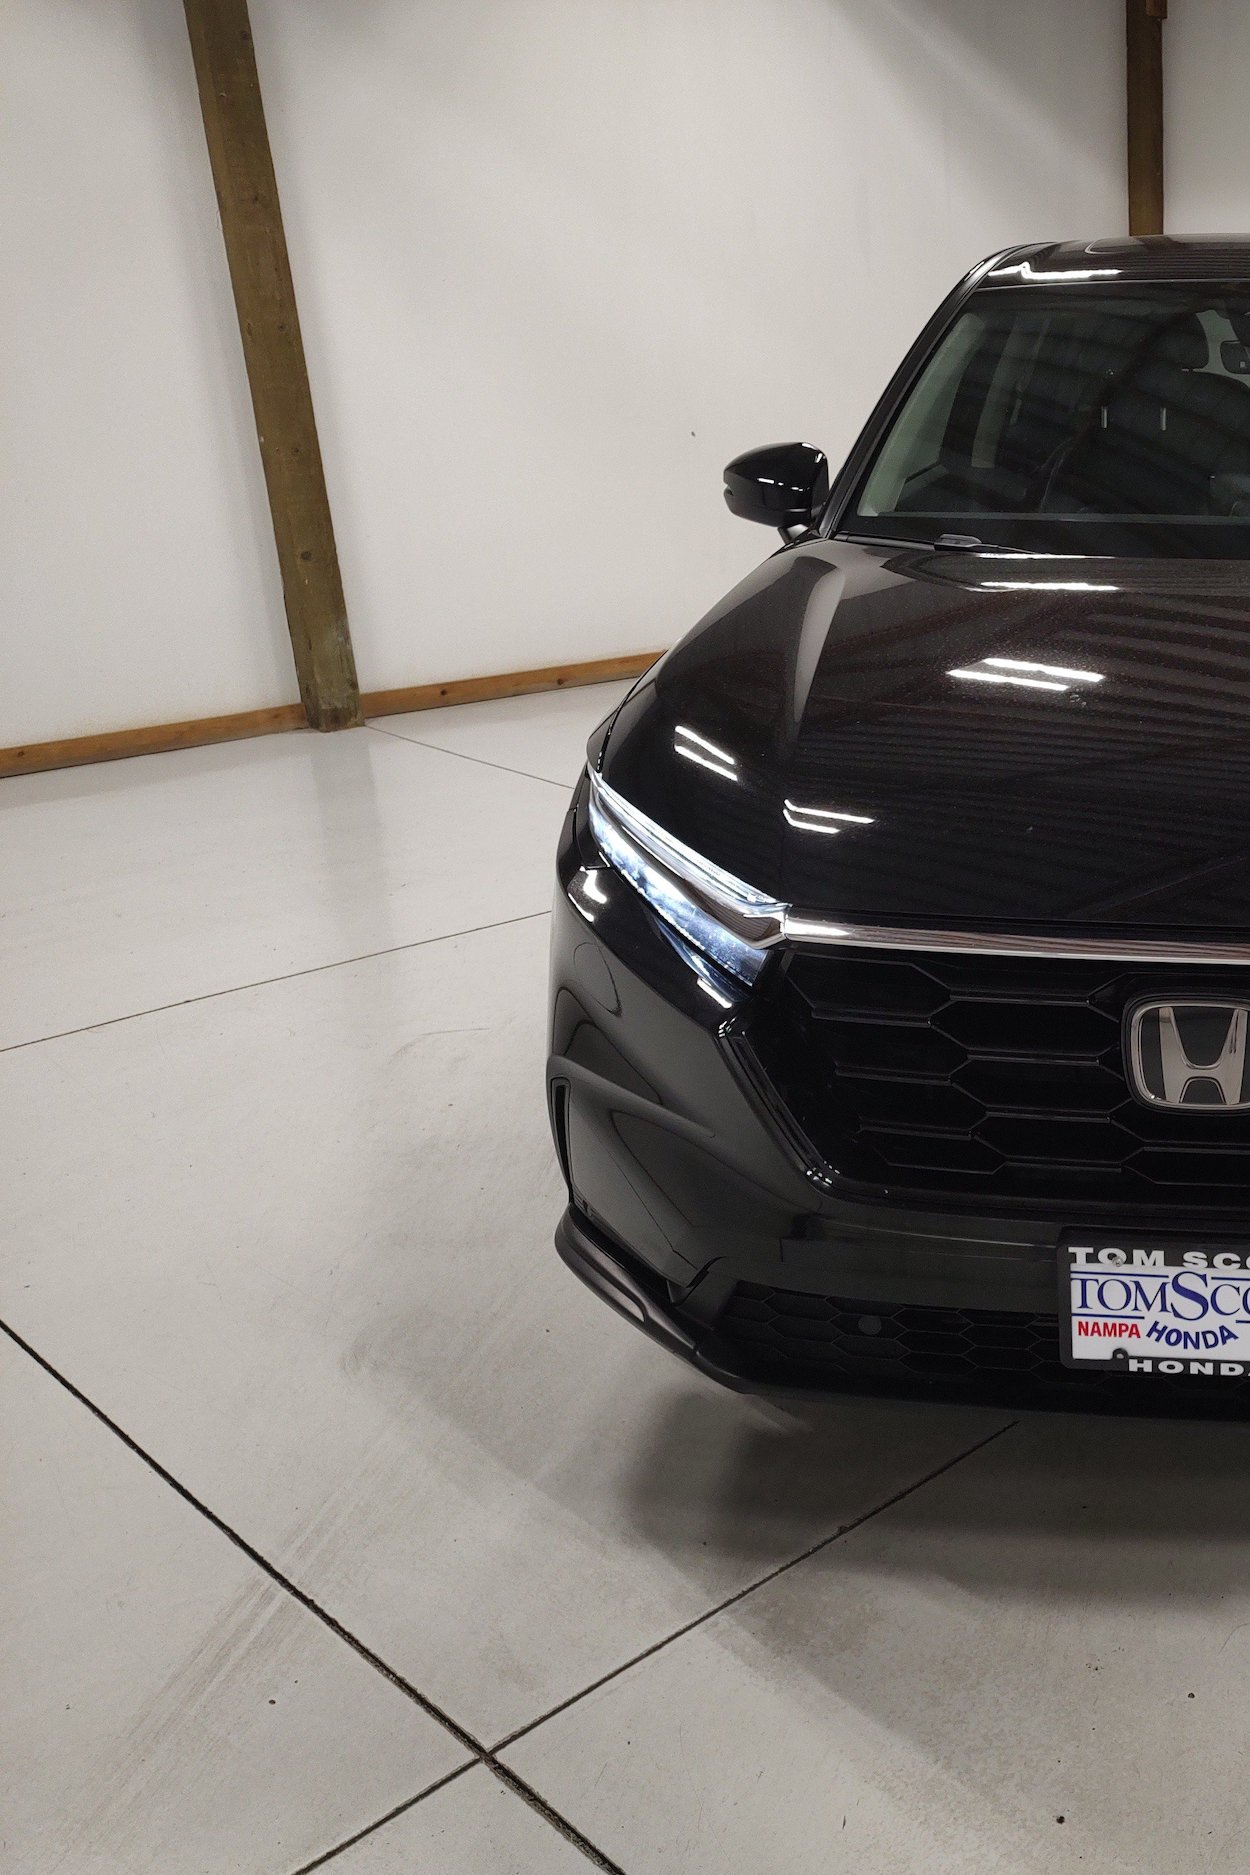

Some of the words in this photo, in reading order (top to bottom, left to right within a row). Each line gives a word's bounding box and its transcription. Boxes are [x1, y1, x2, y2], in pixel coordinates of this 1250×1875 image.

[1068, 1247, 1165, 1267] TOM
[1077, 1321, 1141, 1339] NAMPA
[1146, 1321, 1239, 1350] HONDA
